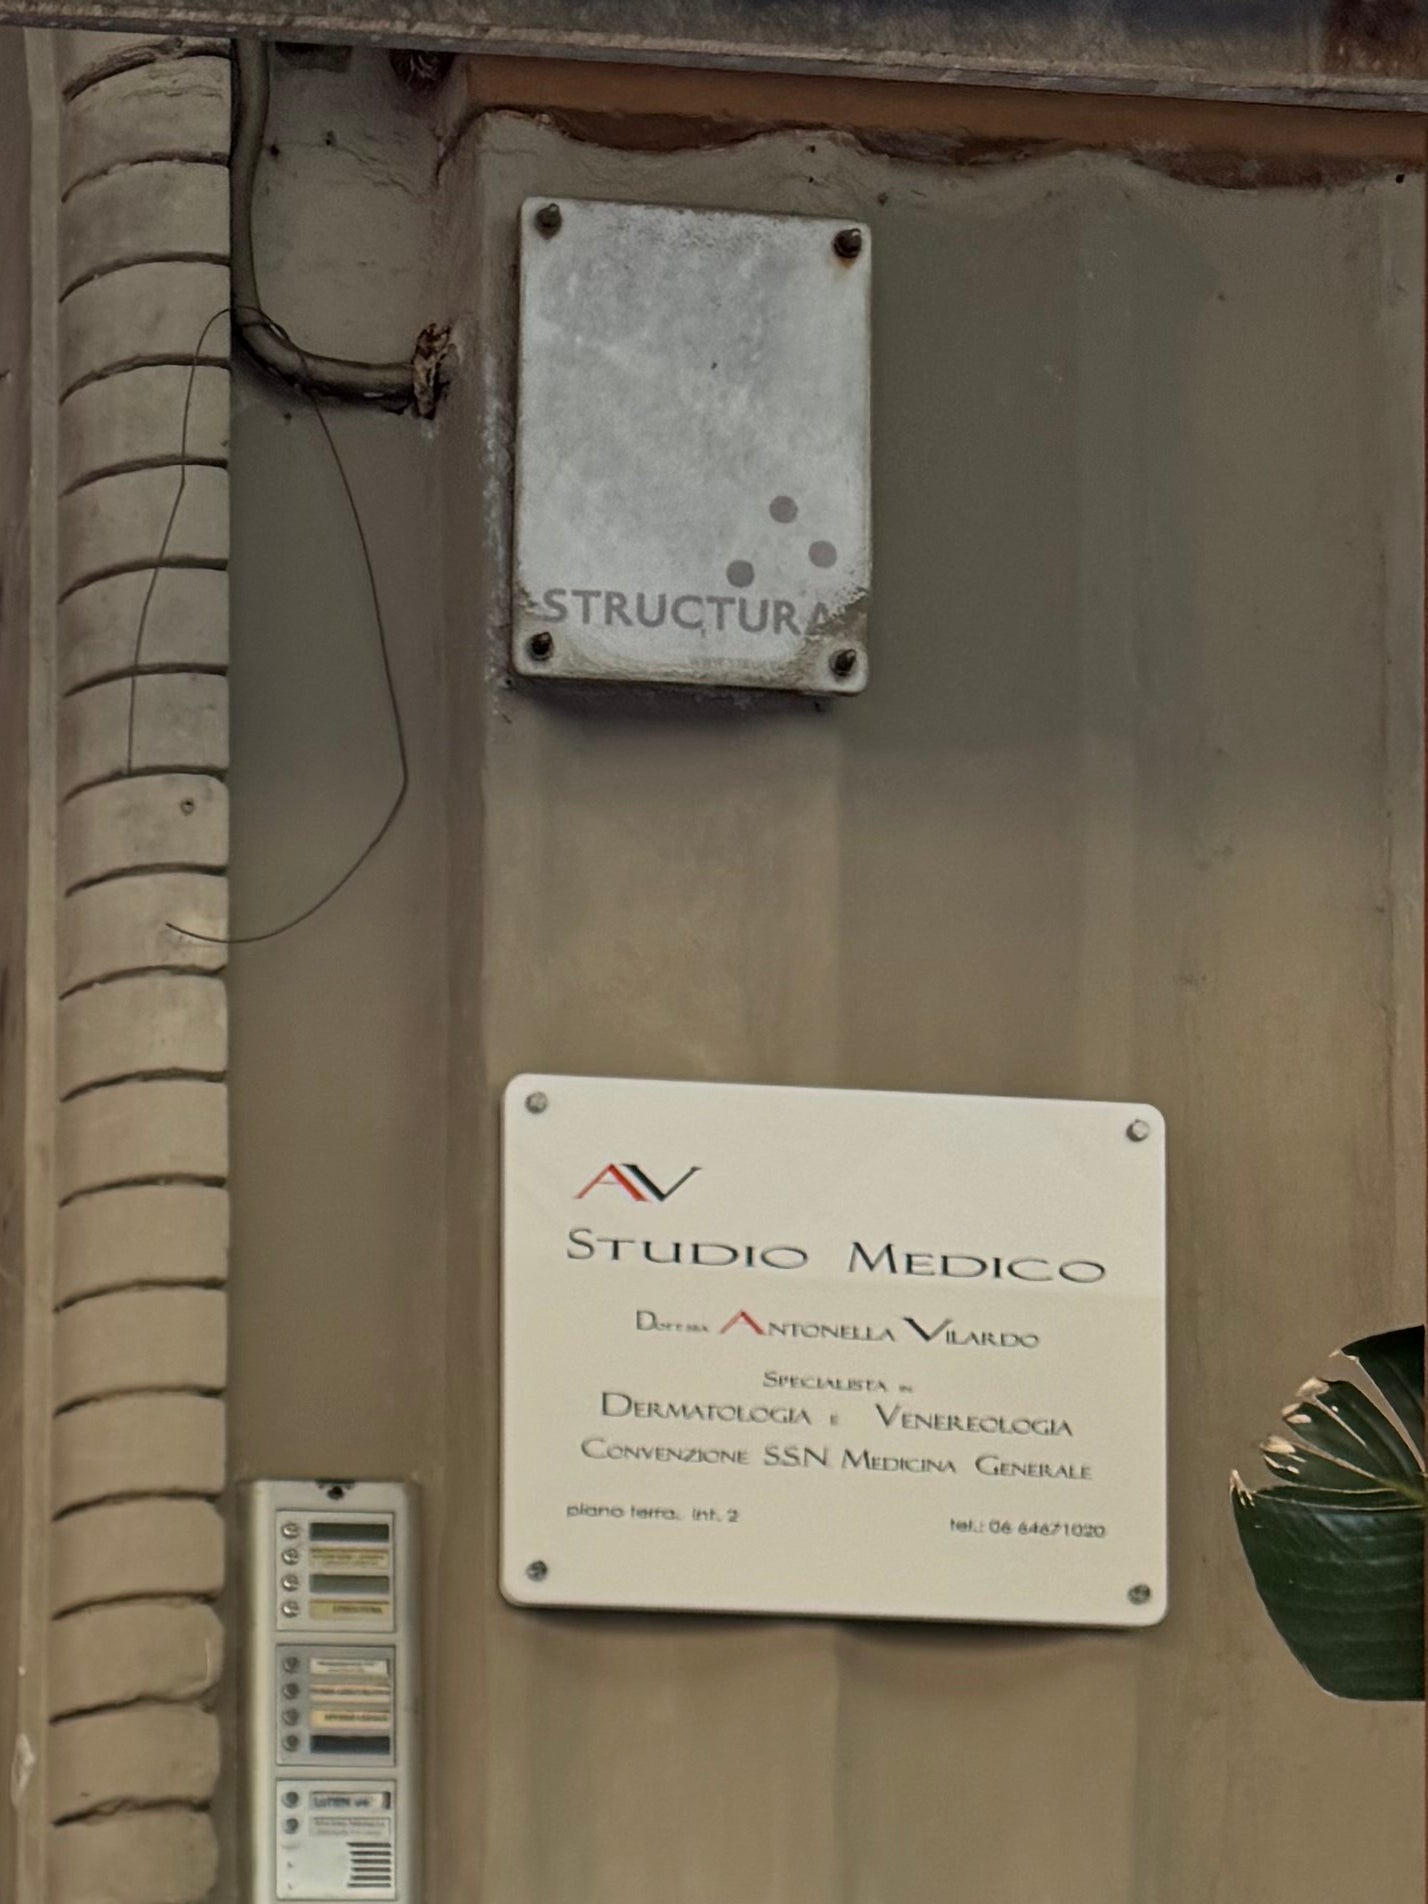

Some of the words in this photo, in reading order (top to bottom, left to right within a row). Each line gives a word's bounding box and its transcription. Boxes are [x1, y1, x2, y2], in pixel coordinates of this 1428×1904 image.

[574, 1163, 702, 1202] AV
[566, 1227, 809, 1270] STUDIO
[848, 1241, 1106, 1283] MEDICO
[718, 1308, 896, 1342] ANTONELLA
[901, 1316, 1040, 1349] VILARDO
[762, 1370, 888, 1393] SPECIALISTA
[601, 1391, 812, 1426] DERMATOLOGIA
[875, 1402, 1074, 1437] VENEREOLOGIA
[580, 1437, 750, 1466] CONVENZIONE
[763, 1445, 831, 1470] SSN
[841, 1448, 957, 1475] MEDICINA
[974, 1453, 1093, 1481] GENERALE
[566, 1503, 624, 1519] piano
[727, 1509, 739, 1523] 2
